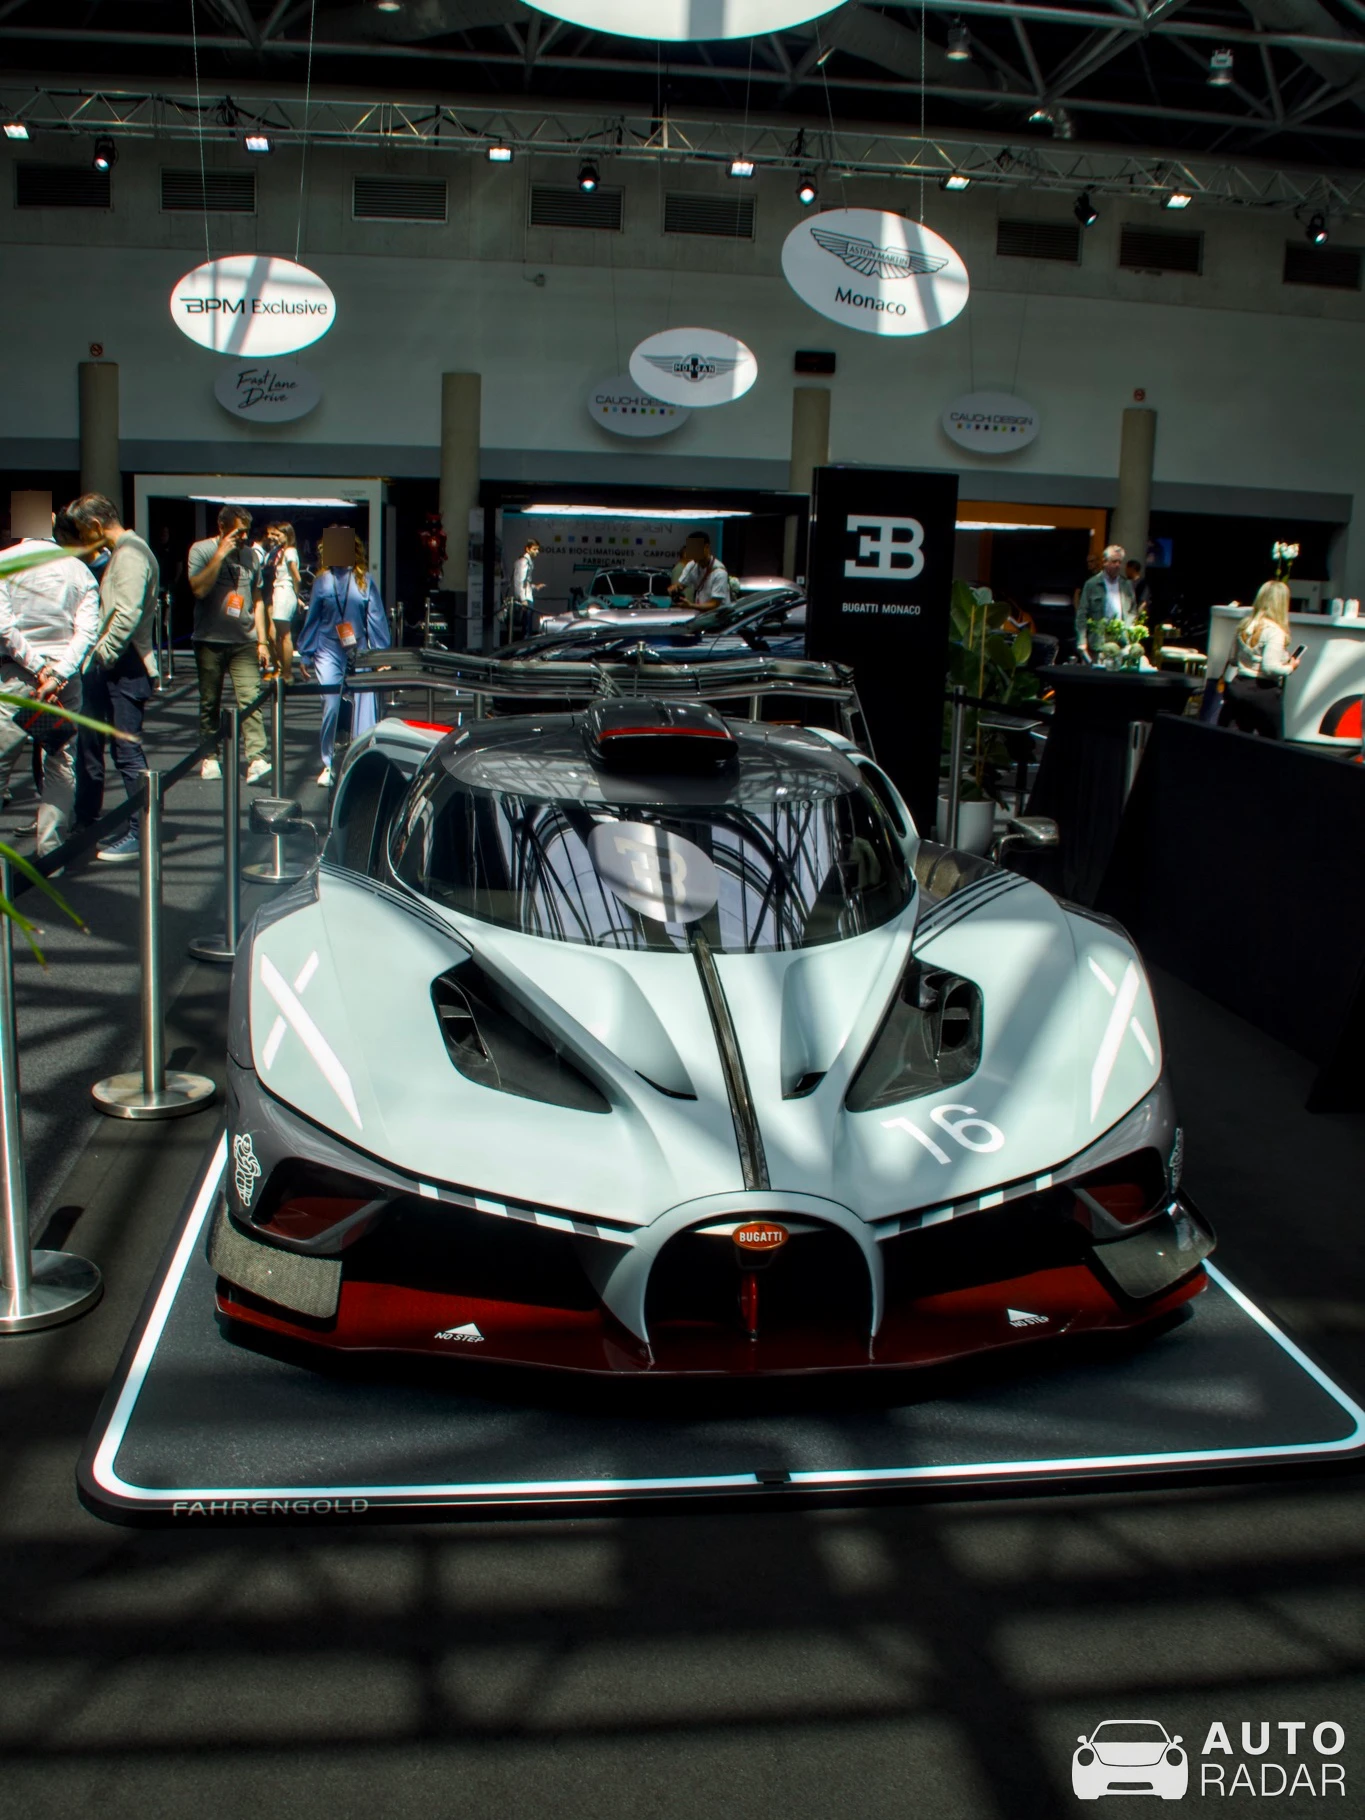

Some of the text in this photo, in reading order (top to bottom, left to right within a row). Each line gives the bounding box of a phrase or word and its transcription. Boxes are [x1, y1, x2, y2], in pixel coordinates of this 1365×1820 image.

[849, 245, 909, 265] ASTON MARTIN
[180, 298, 328, 315] BPM Exclusive
[835, 286, 907, 316] Monaco
[674, 363, 715, 373] MORGAN
[236, 368, 298, 392] Fast Lane
[238, 387, 288, 409] Drive
[596, 395, 638, 405] CAUCHI
[950, 412, 1033, 426] CAUCHI DESIGN
[569, 547, 635, 557] BIOCLIMATIQUES
[583, 557, 626, 565] FABRICANT
[842, 602, 921, 615] BUGATTI MONACO
[880, 1104, 1005, 1165] 16
[739, 1231, 783, 1243] BUGATTI
[1009, 1315, 1050, 1328] NO STEP
[434, 1332, 485, 1343] NO STEP
[172, 1498, 369, 1517] FAHRENGOLD
